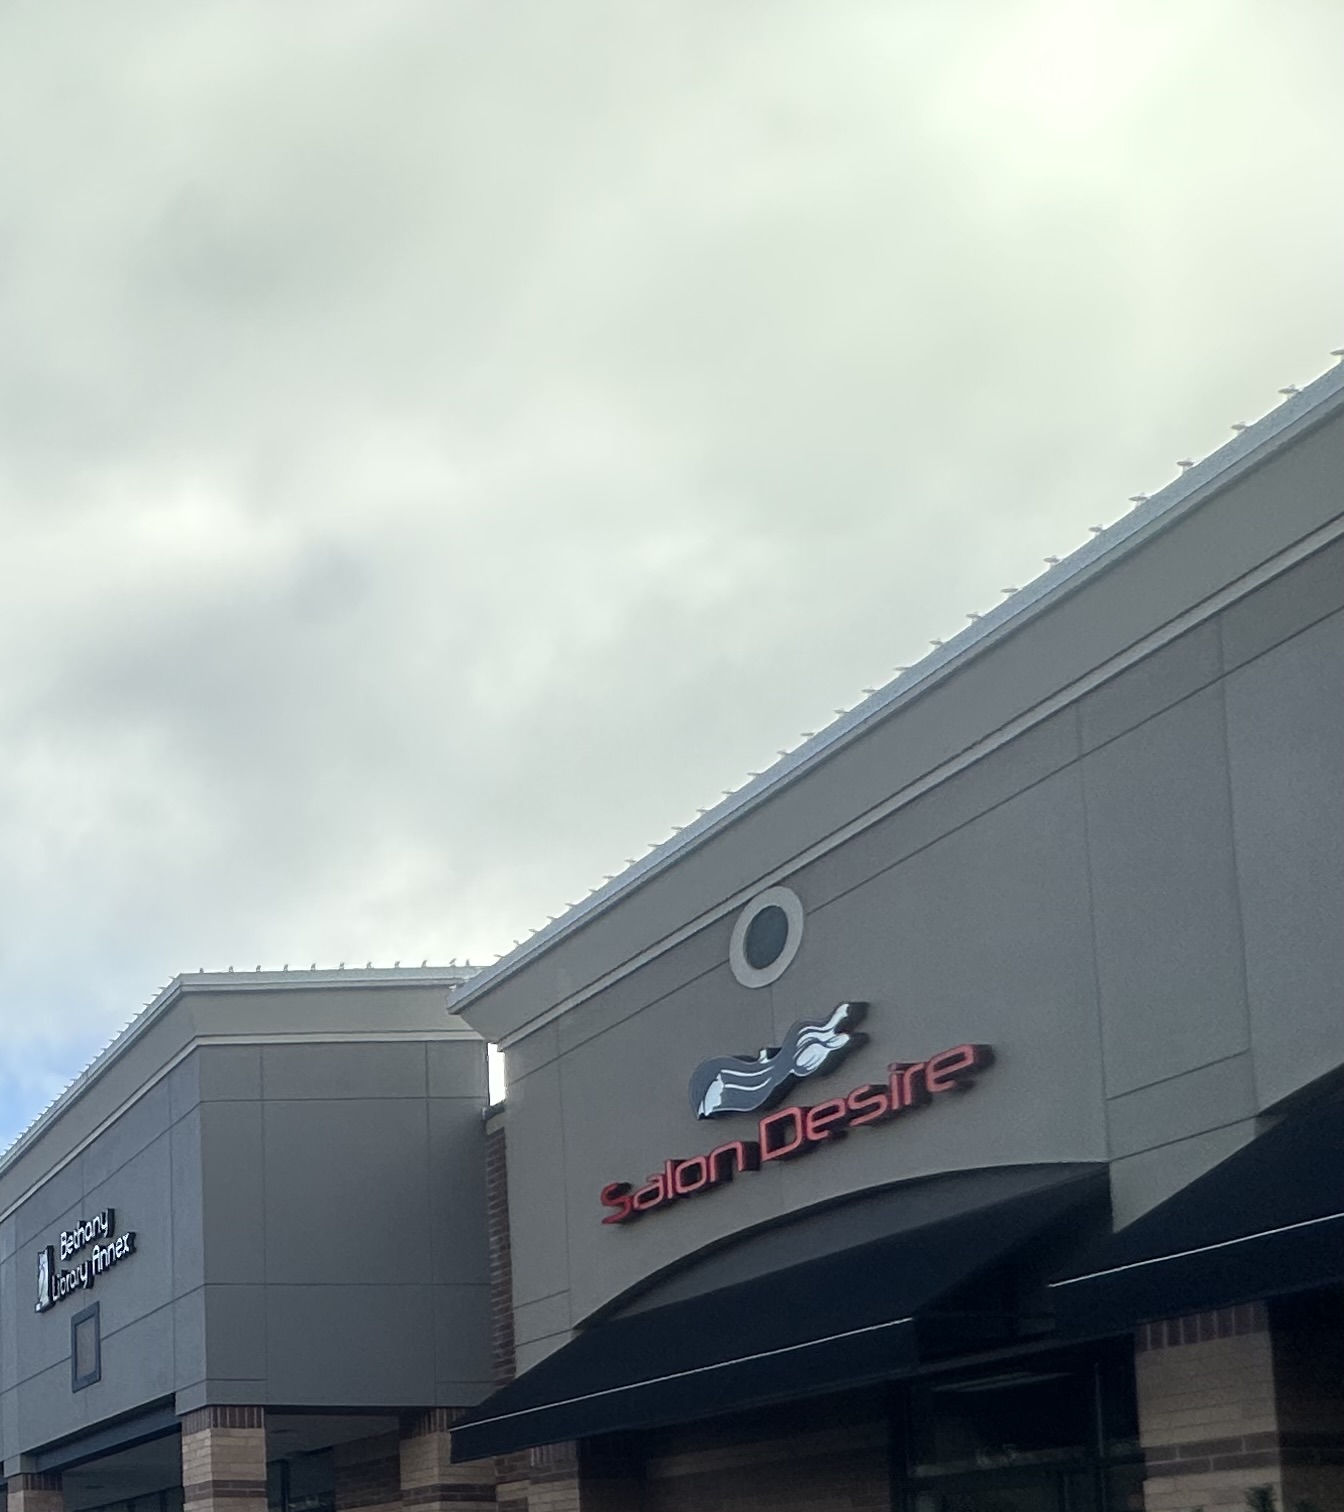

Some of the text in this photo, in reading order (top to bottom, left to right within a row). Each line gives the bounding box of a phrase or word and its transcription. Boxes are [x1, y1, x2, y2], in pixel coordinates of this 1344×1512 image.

[599, 1043, 976, 1225] Salon Desire
[51, 1232, 130, 1302] Library Annex
[60, 1208, 110, 1261] Bethany
